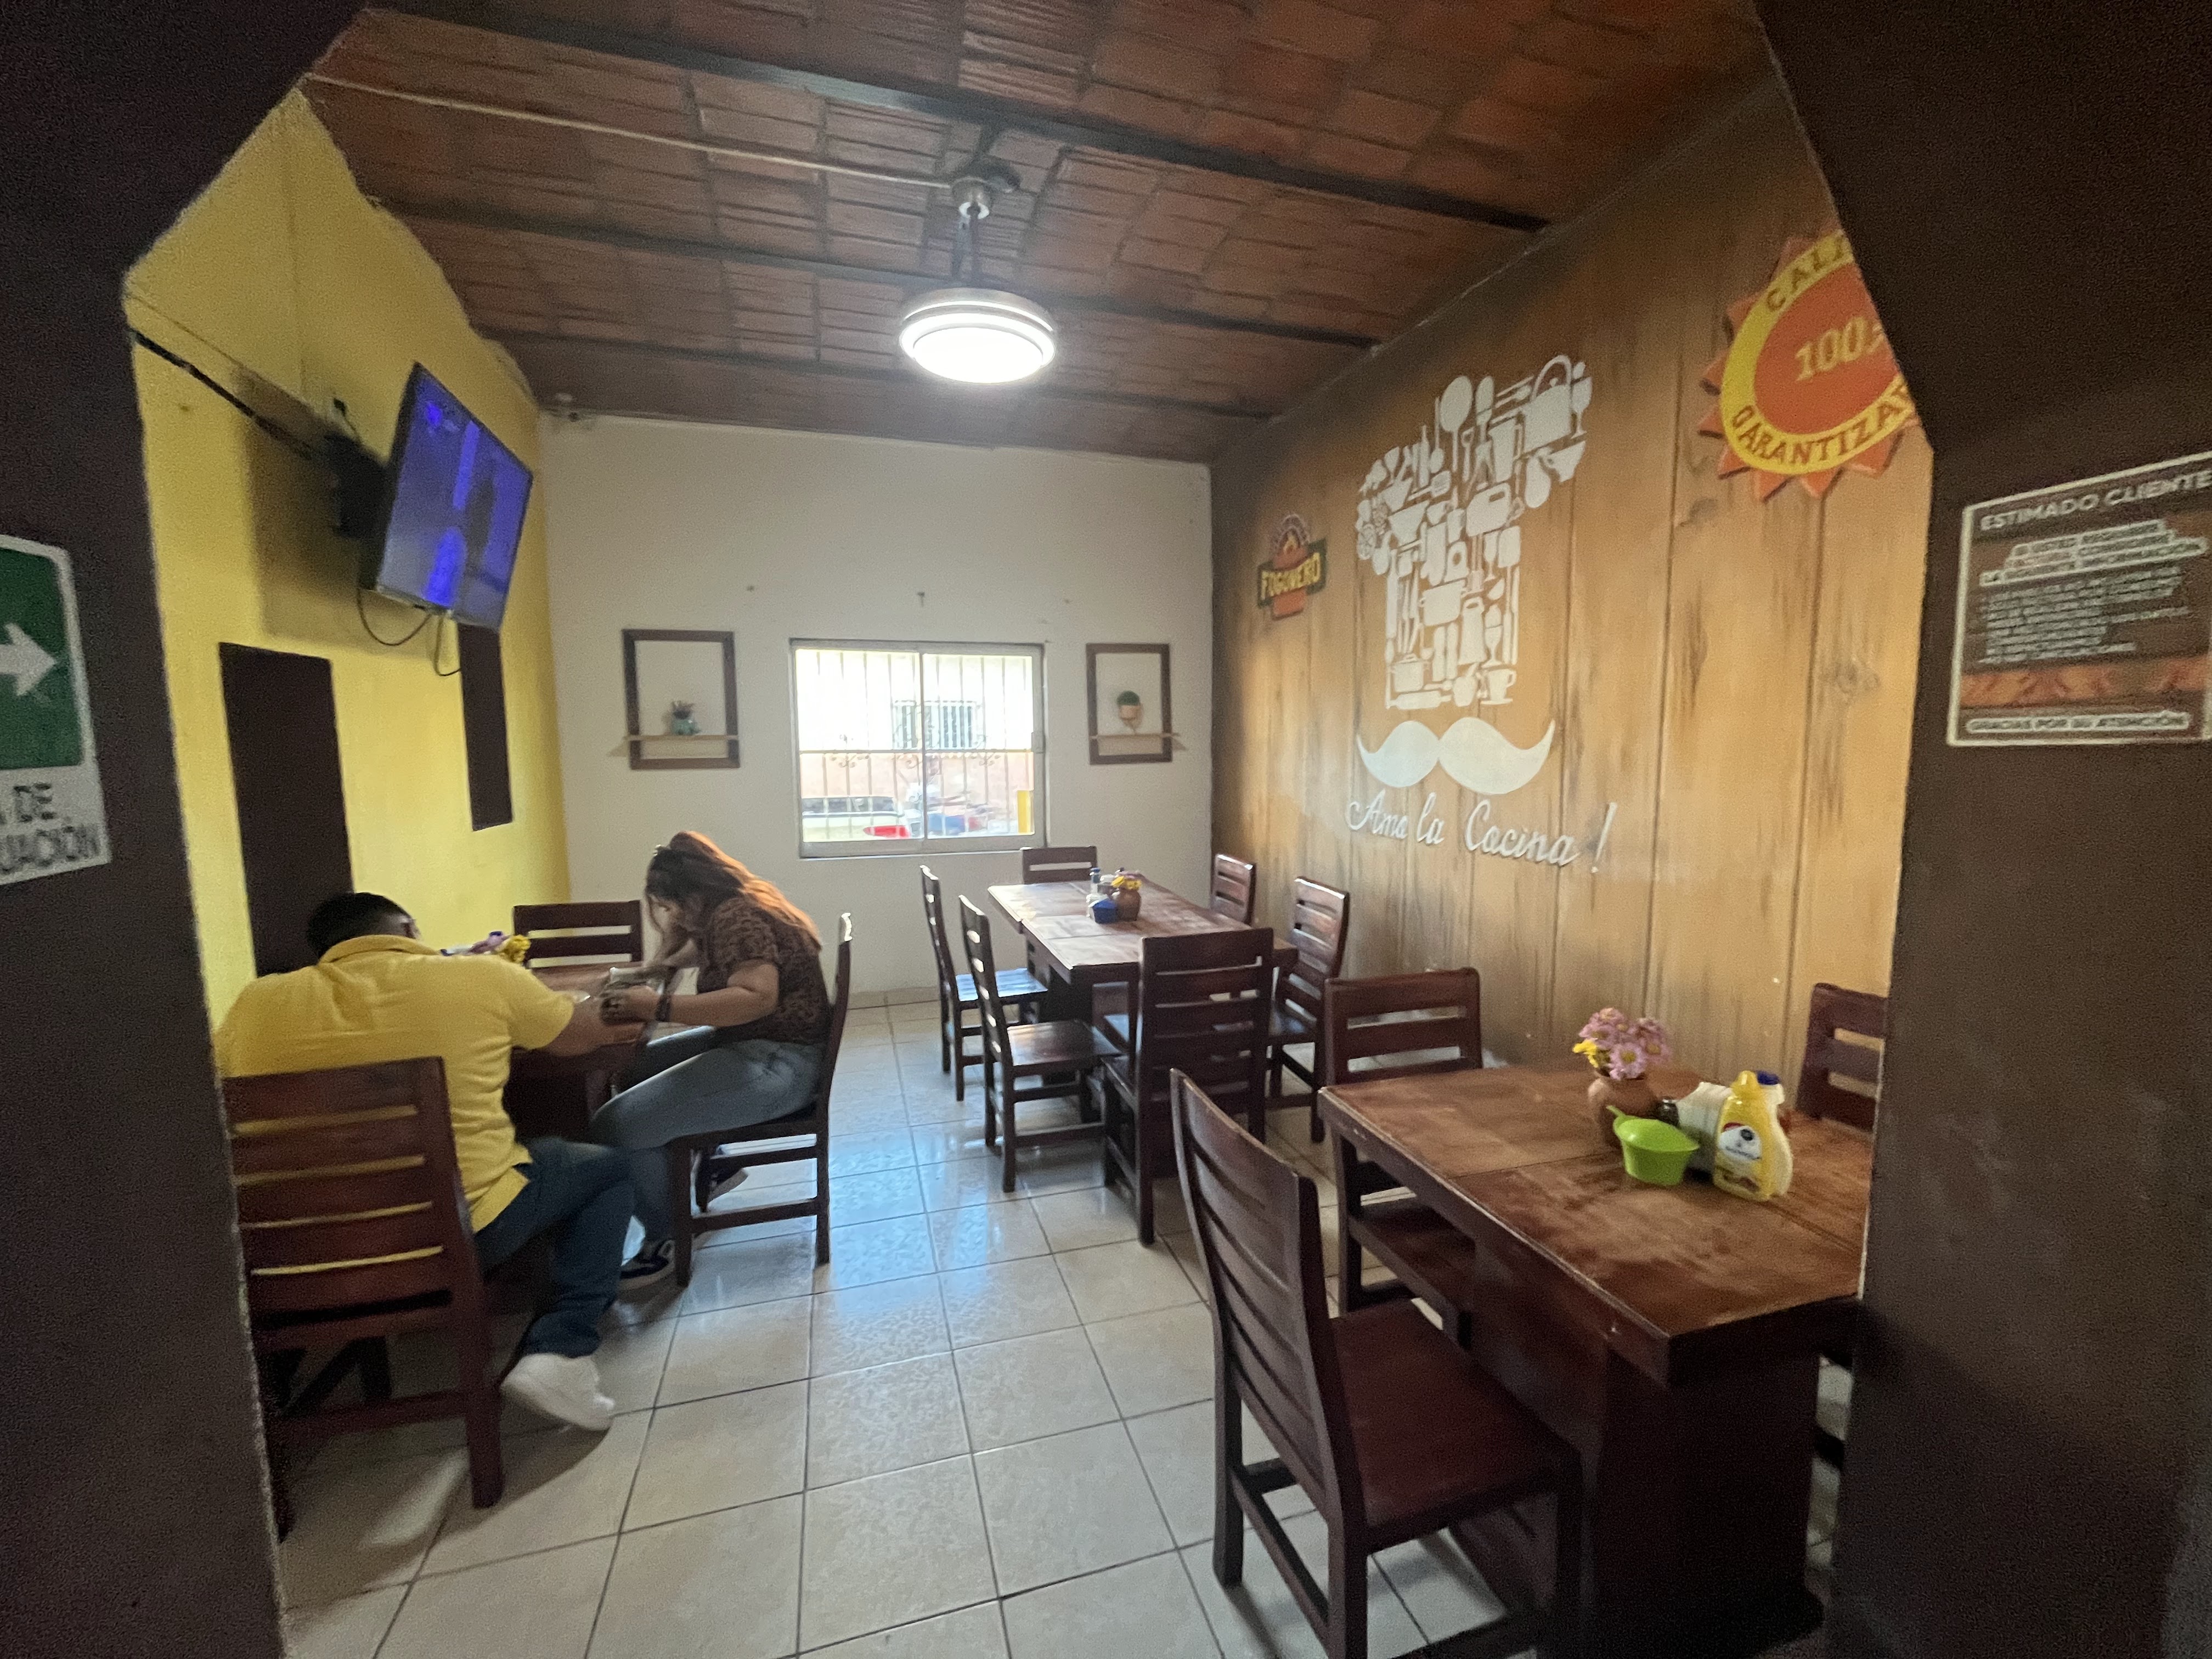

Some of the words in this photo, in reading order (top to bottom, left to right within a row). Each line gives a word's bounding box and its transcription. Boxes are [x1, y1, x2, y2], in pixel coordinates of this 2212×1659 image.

[1980, 493, 2100, 531] ESTIMADO
[2103, 470, 2212, 507] CLIENTE
[13, 782, 57, 823] DE
[1346, 789, 1408, 839] Ama
[1417, 792, 1444, 846] la
[1464, 799, 1580, 867] Cocina
